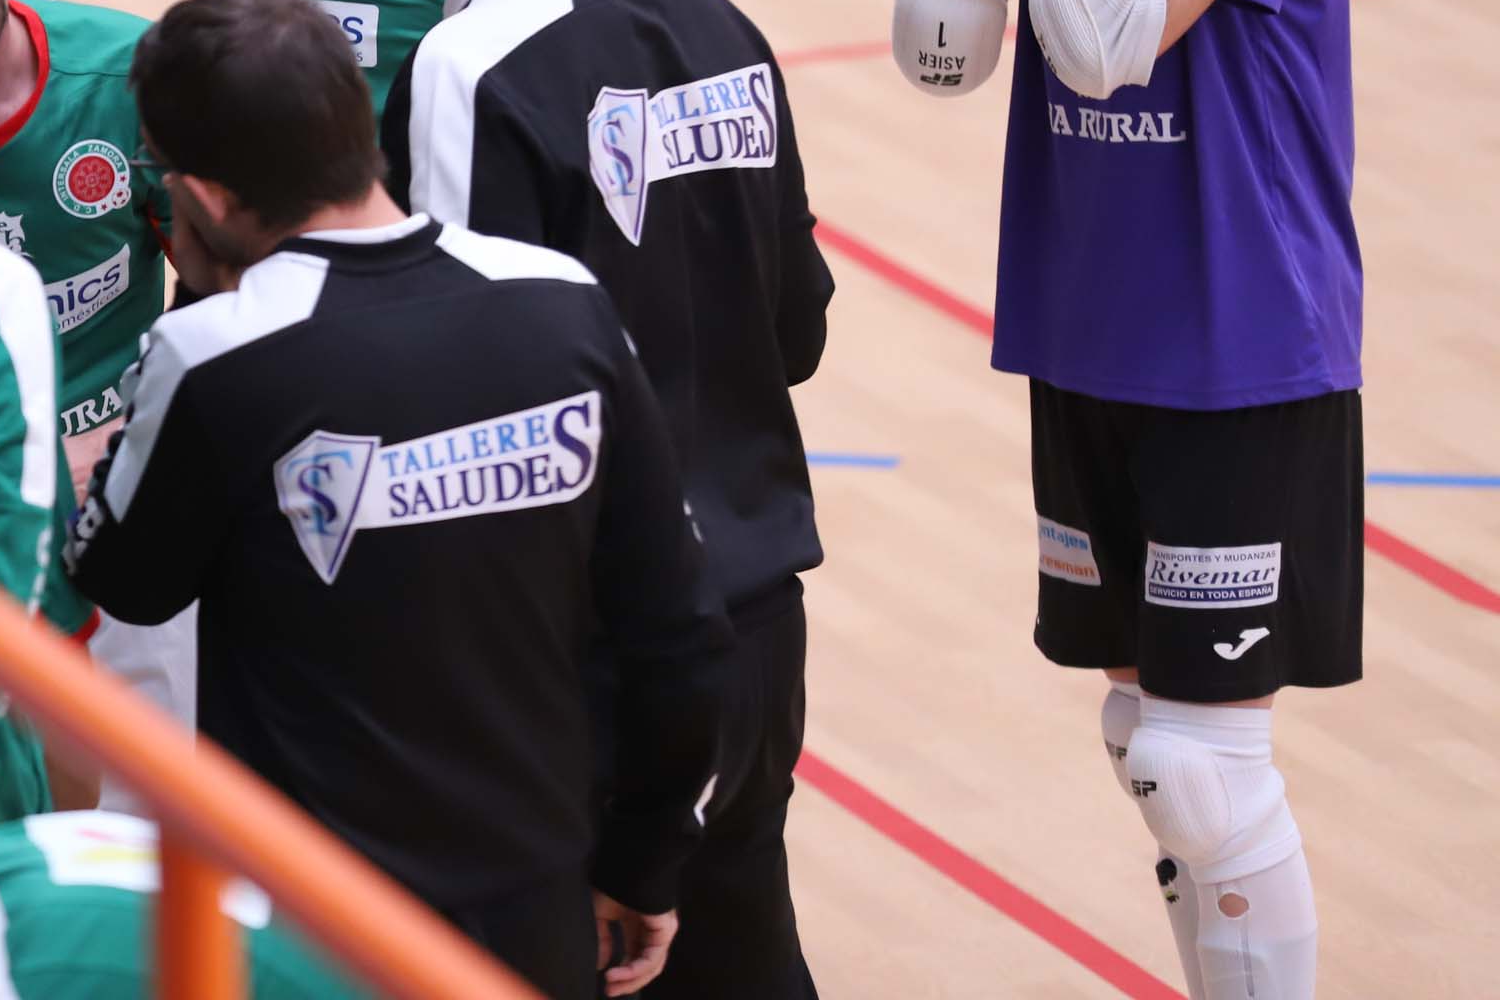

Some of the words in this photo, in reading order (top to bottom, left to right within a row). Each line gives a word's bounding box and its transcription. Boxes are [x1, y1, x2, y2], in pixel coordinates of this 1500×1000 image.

[937, 21, 947, 48] 1
[918, 50, 966, 70] ASIER
[1078, 107, 1187, 143] RURAL
[57, 149, 80, 202] INTERSALA
[87, 143, 124, 170] ZAMORA
[381, 402, 593, 478] TALLERES
[389, 425, 593, 518] SALUDES
[1224, 549, 1276, 562] MUDANZAS
[1150, 560, 1275, 584] Rivemar
[1190, 590, 1205, 599] EN
[1207, 590, 1237, 600] TODA
[1238, 585, 1273, 598] ESPAÑA
